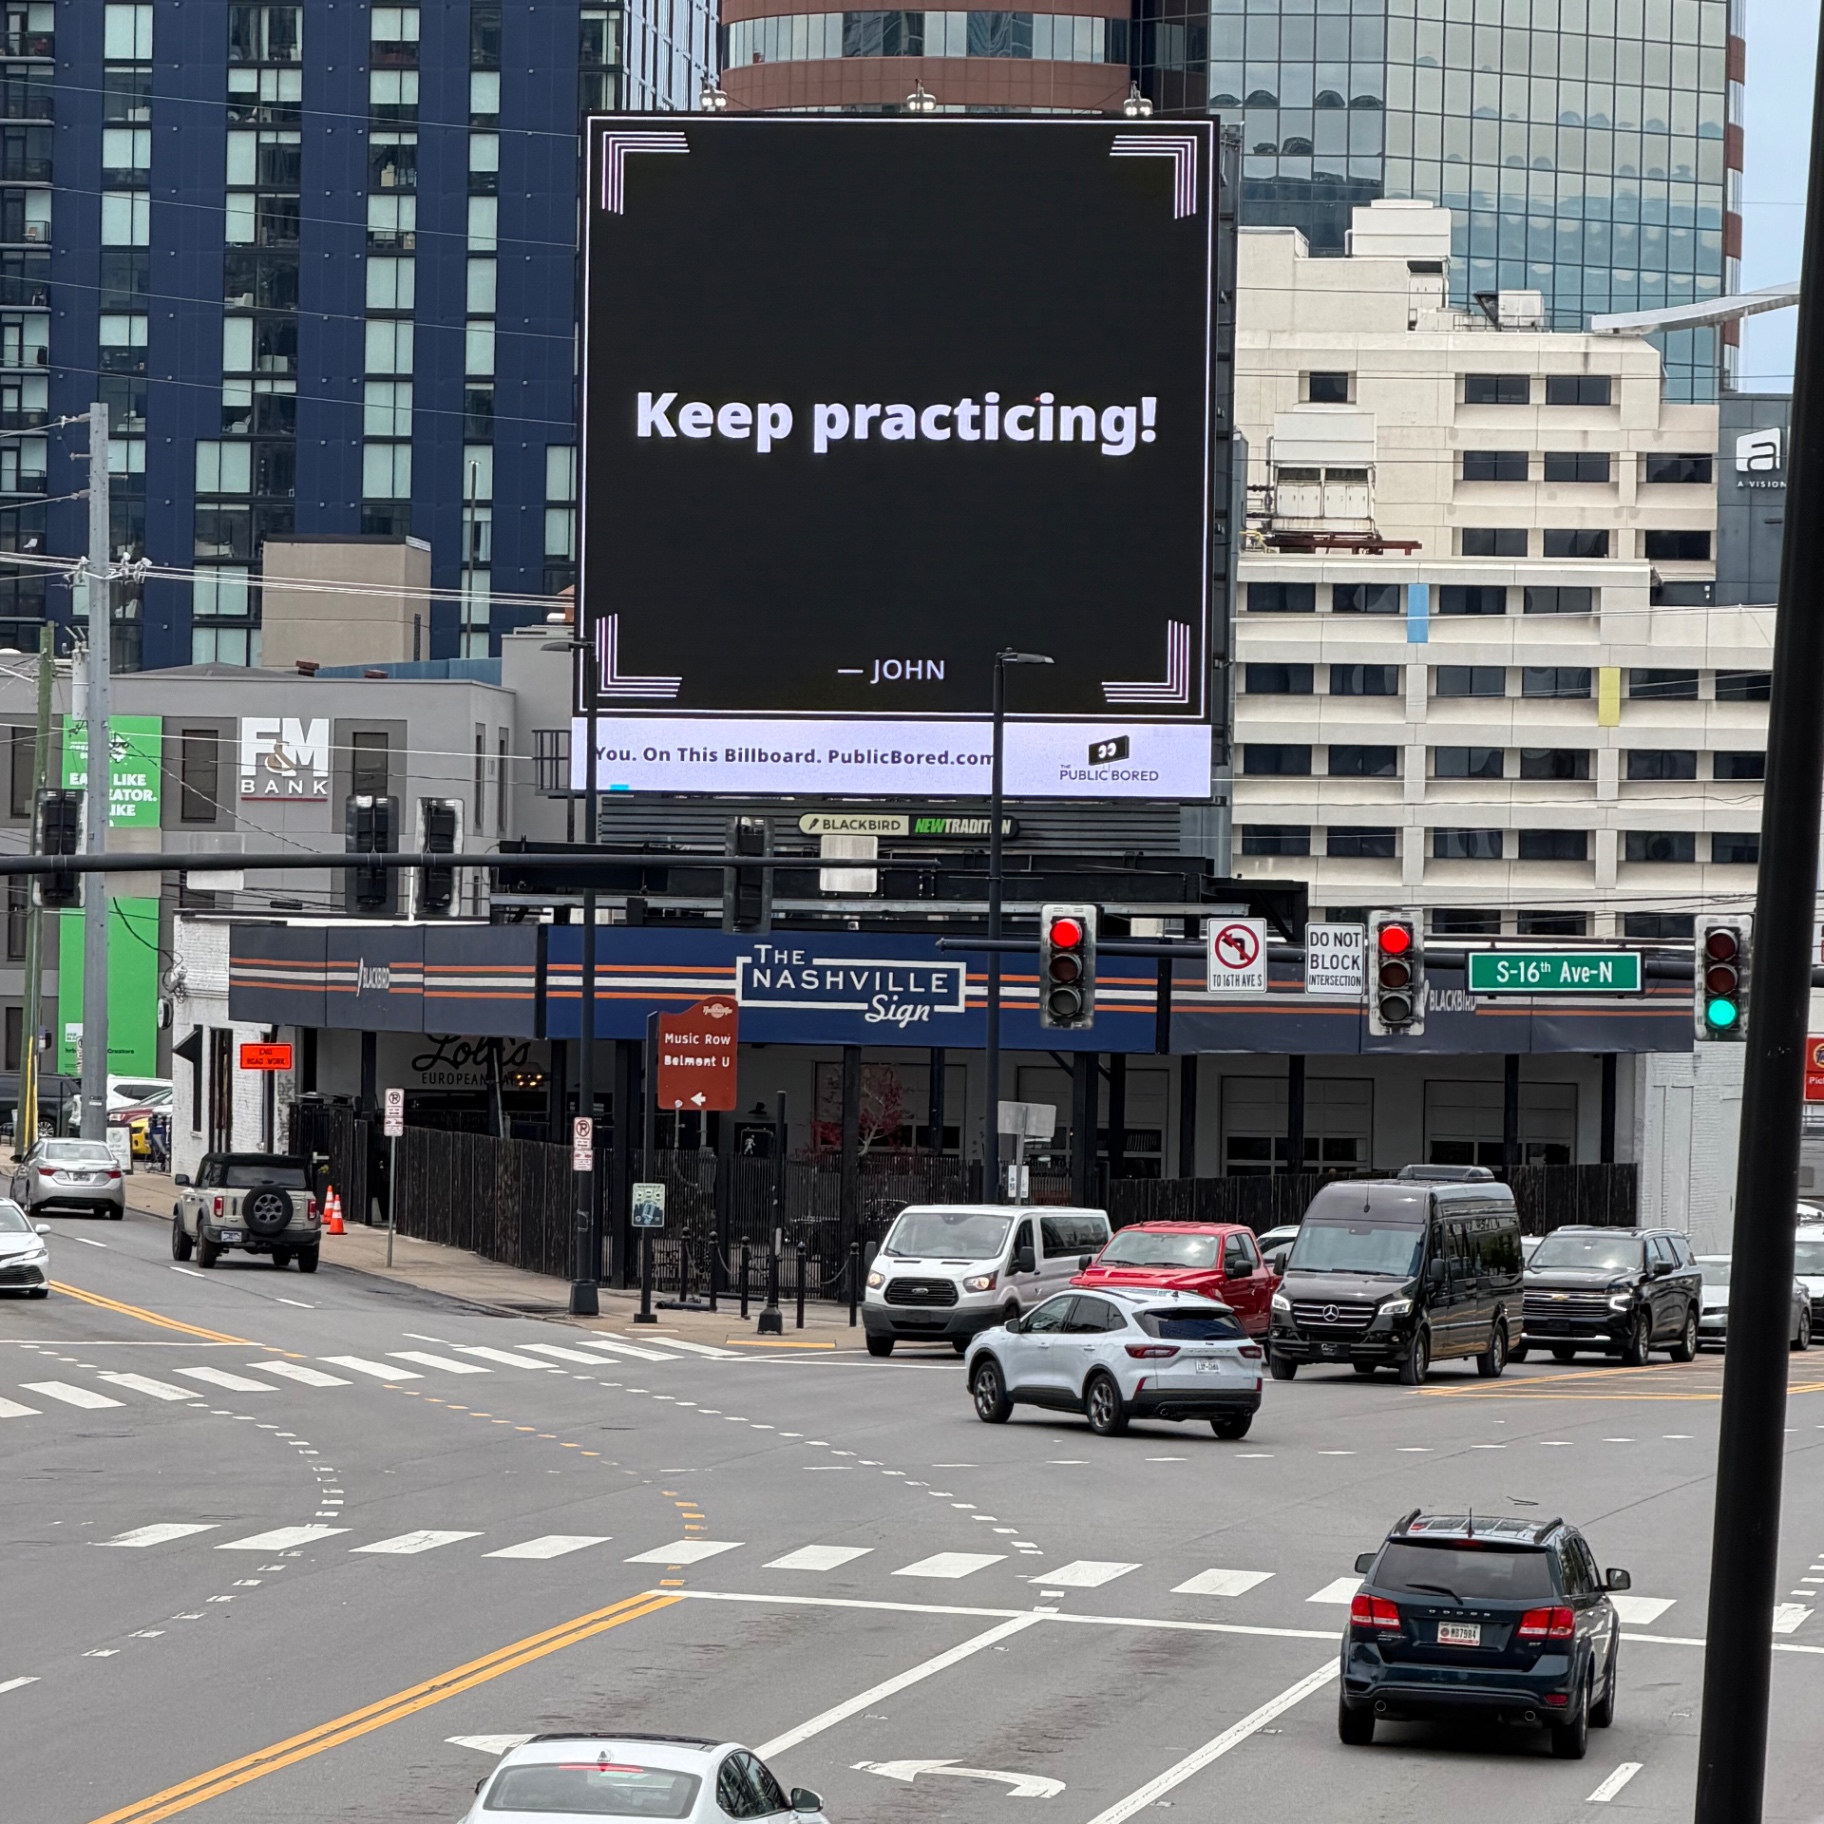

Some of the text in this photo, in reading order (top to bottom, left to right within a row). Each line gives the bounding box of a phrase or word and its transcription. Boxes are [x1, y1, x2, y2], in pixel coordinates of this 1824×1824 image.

[637, 391, 1157, 456] Keep practicing!
[870, 659, 945, 684] JOHN
[240, 717, 329, 777] F&M
[595, 747, 994, 766] You. On This Billboard. PublicBored.com
[113, 773, 147, 786] LIKE
[1060, 770, 1159, 781] PUBLIC BORED
[108, 788, 158, 802] ATOR.
[240, 779, 328, 795] BANK
[822, 818, 1011, 835] BLACKBIRD NEWTRADITN
[1310, 931, 1361, 948] DO NOT
[1310, 954, 1361, 971] BLOCK
[752, 968, 948, 993] NASHVILLE
[1213, 974, 1263, 987] TO 16TH AVE S
[1309, 974, 1362, 987] INTERSECTION
[1496, 960, 1613, 984] S-16th Ave-N
[1429, 989, 1476, 1012] BLACKBIRD
[864, 994, 930, 1028] Sign
[664, 1032, 731, 1045] Music Row
[411, 1034, 531, 1072] Lol's
[664, 1054, 730, 1068] Belmont U
[422, 1072, 487, 1086] EUROPEAN
